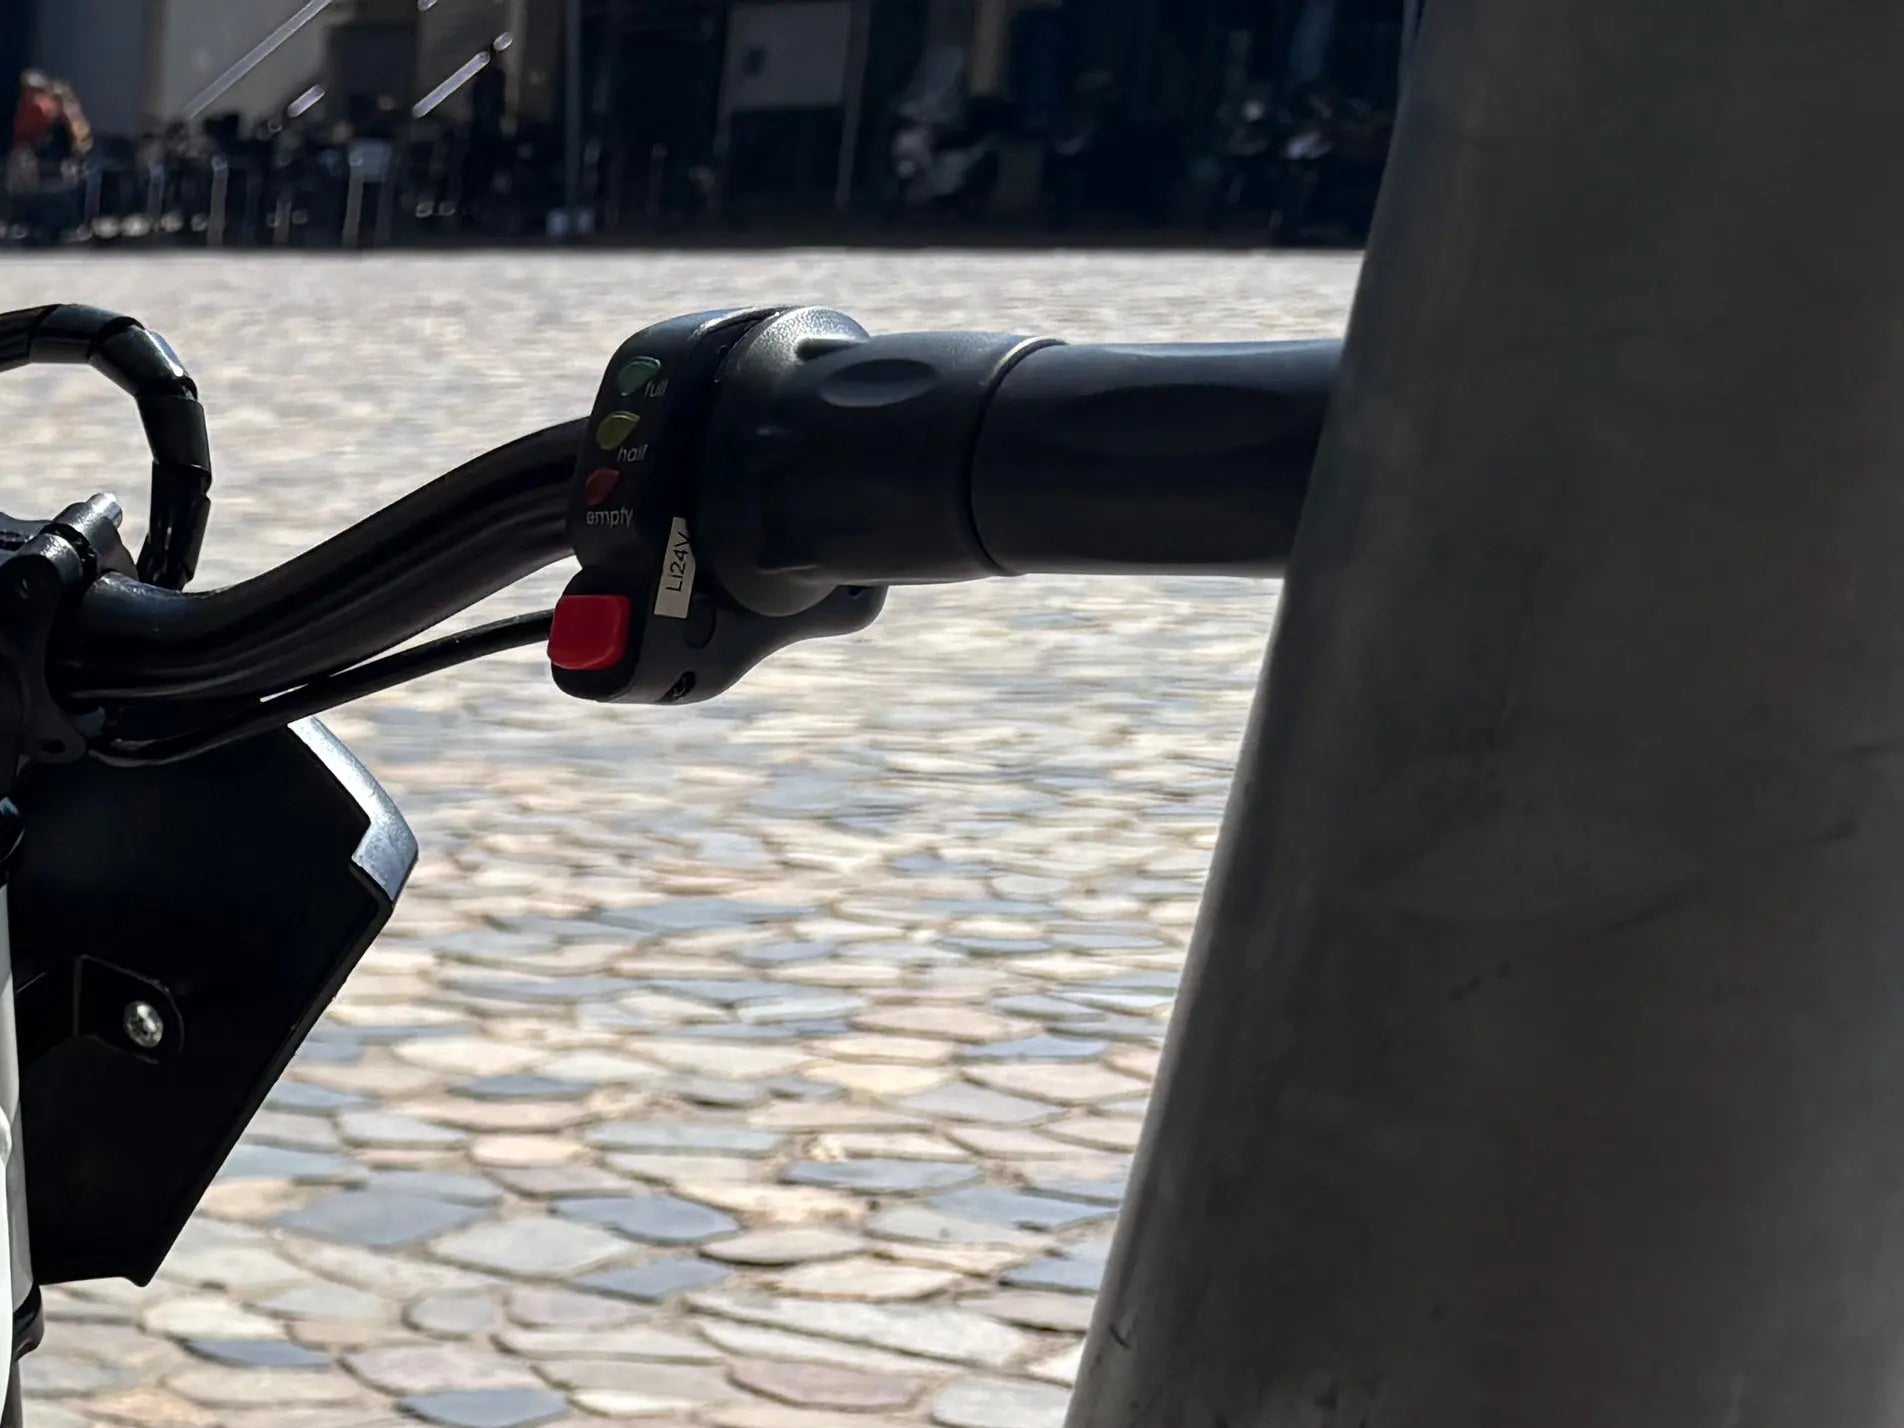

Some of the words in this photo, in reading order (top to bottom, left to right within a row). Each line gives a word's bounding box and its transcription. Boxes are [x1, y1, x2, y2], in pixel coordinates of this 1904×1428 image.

[645, 380, 668, 397] full
[617, 443, 648, 461] half
[586, 507, 633, 527] empty
